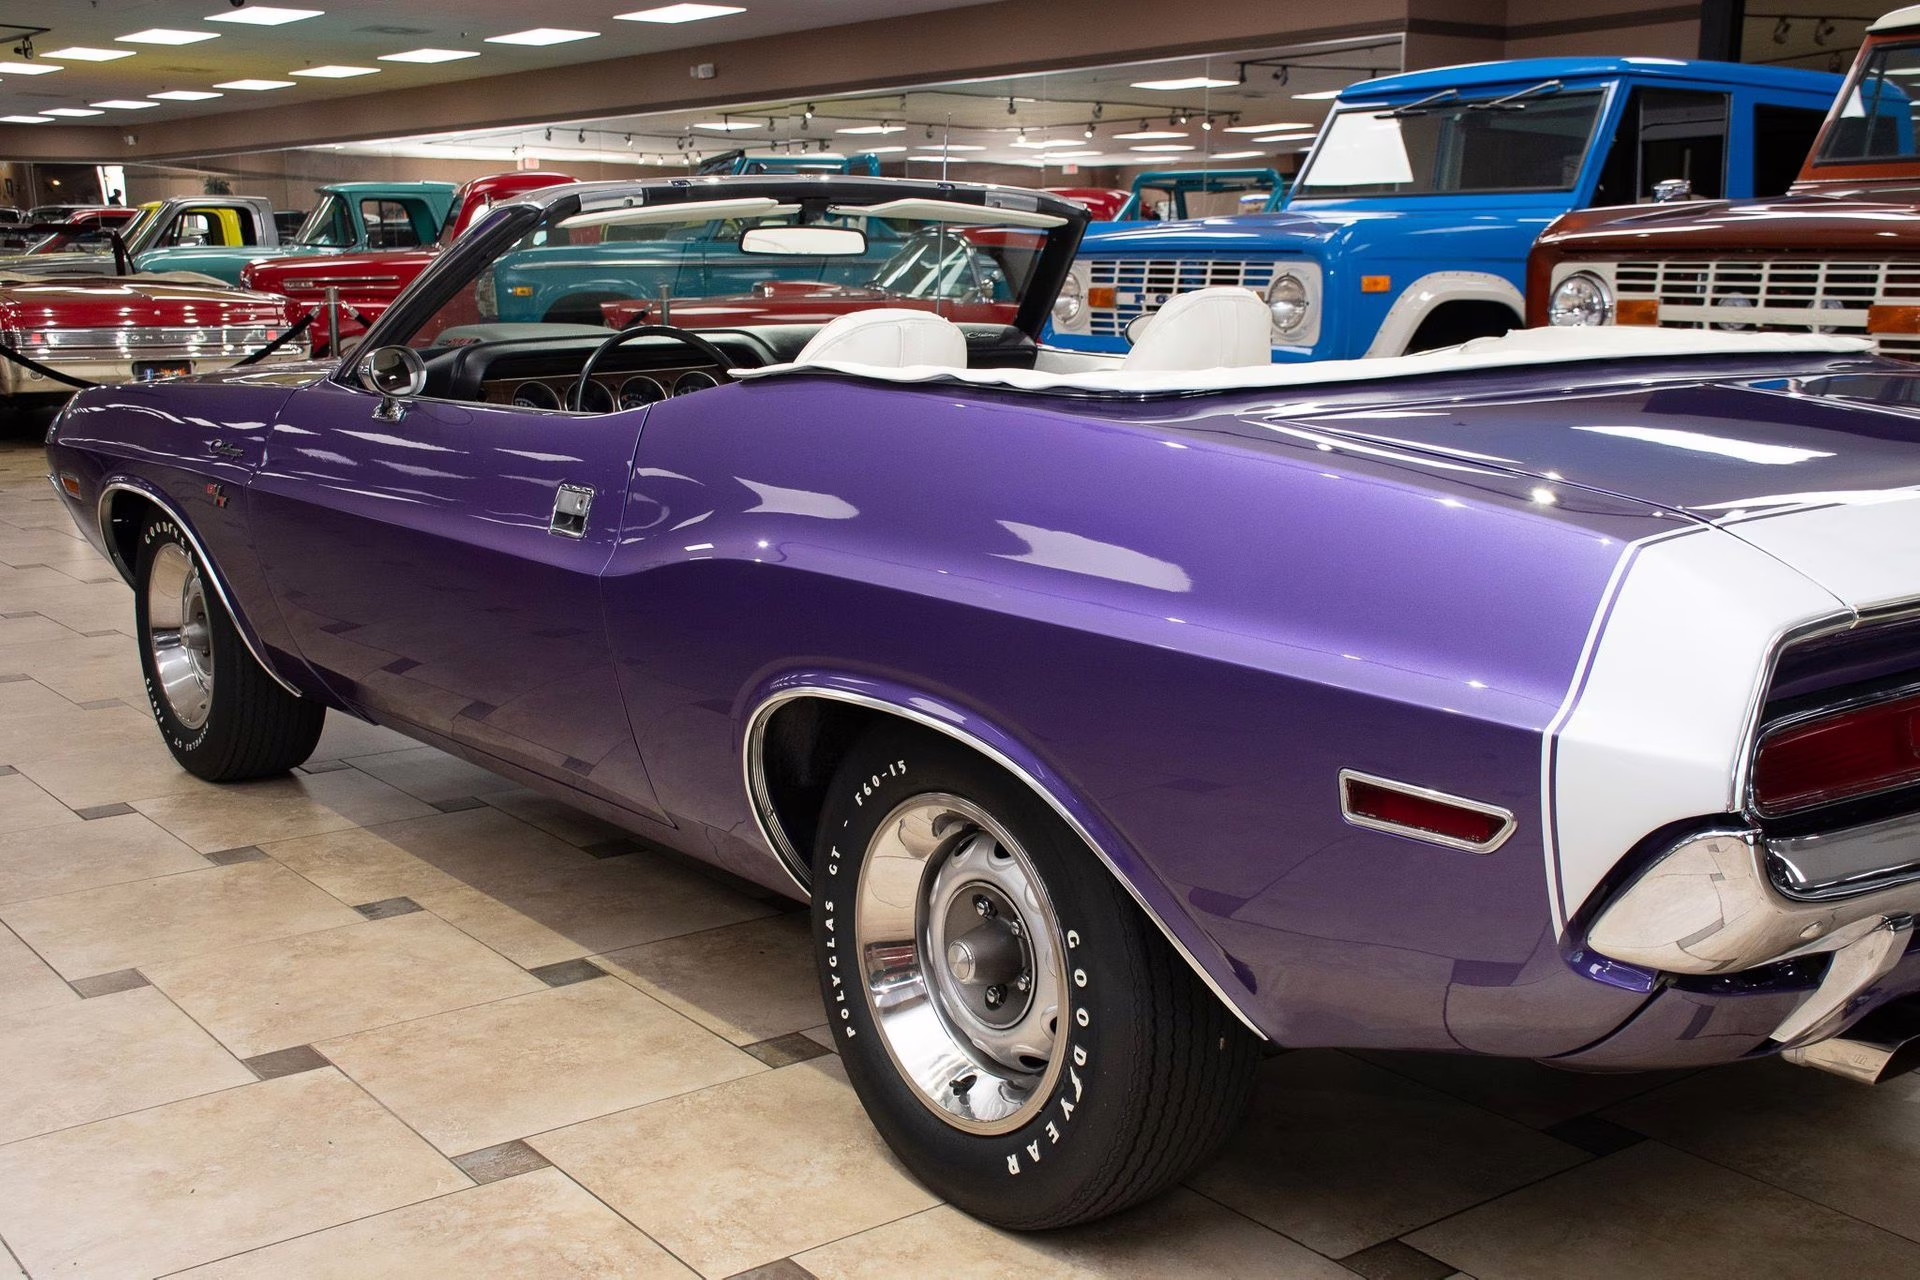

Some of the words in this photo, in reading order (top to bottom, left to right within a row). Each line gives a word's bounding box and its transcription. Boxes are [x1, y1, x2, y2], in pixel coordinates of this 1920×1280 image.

[854, 760, 907, 807] F60-15
[828, 846, 841, 876] GT
[825, 900, 856, 1039] POLYGLAS
[1006, 929, 1090, 1175] GOODYEAR
